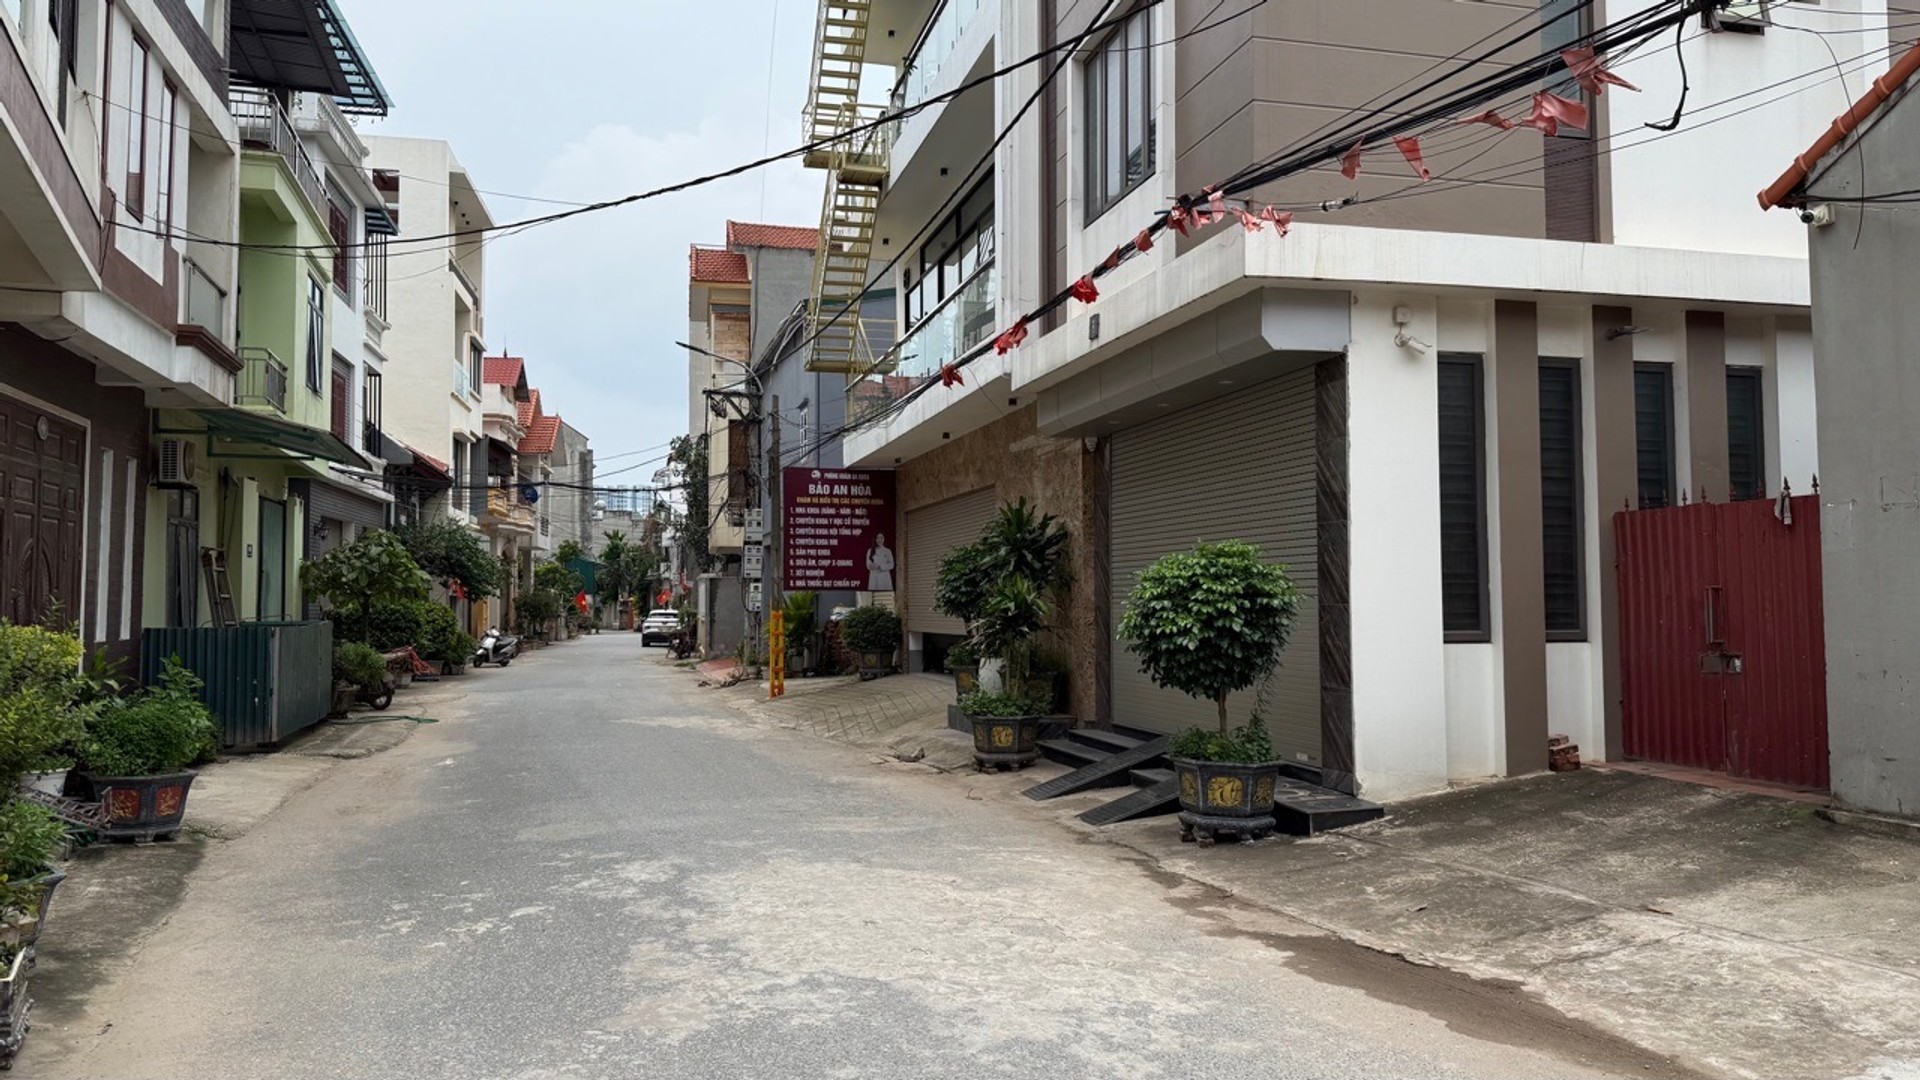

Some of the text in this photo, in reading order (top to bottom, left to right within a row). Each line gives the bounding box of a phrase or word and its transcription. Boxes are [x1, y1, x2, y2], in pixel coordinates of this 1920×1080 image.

[809, 481, 872, 496] BẢO AN HÒA
